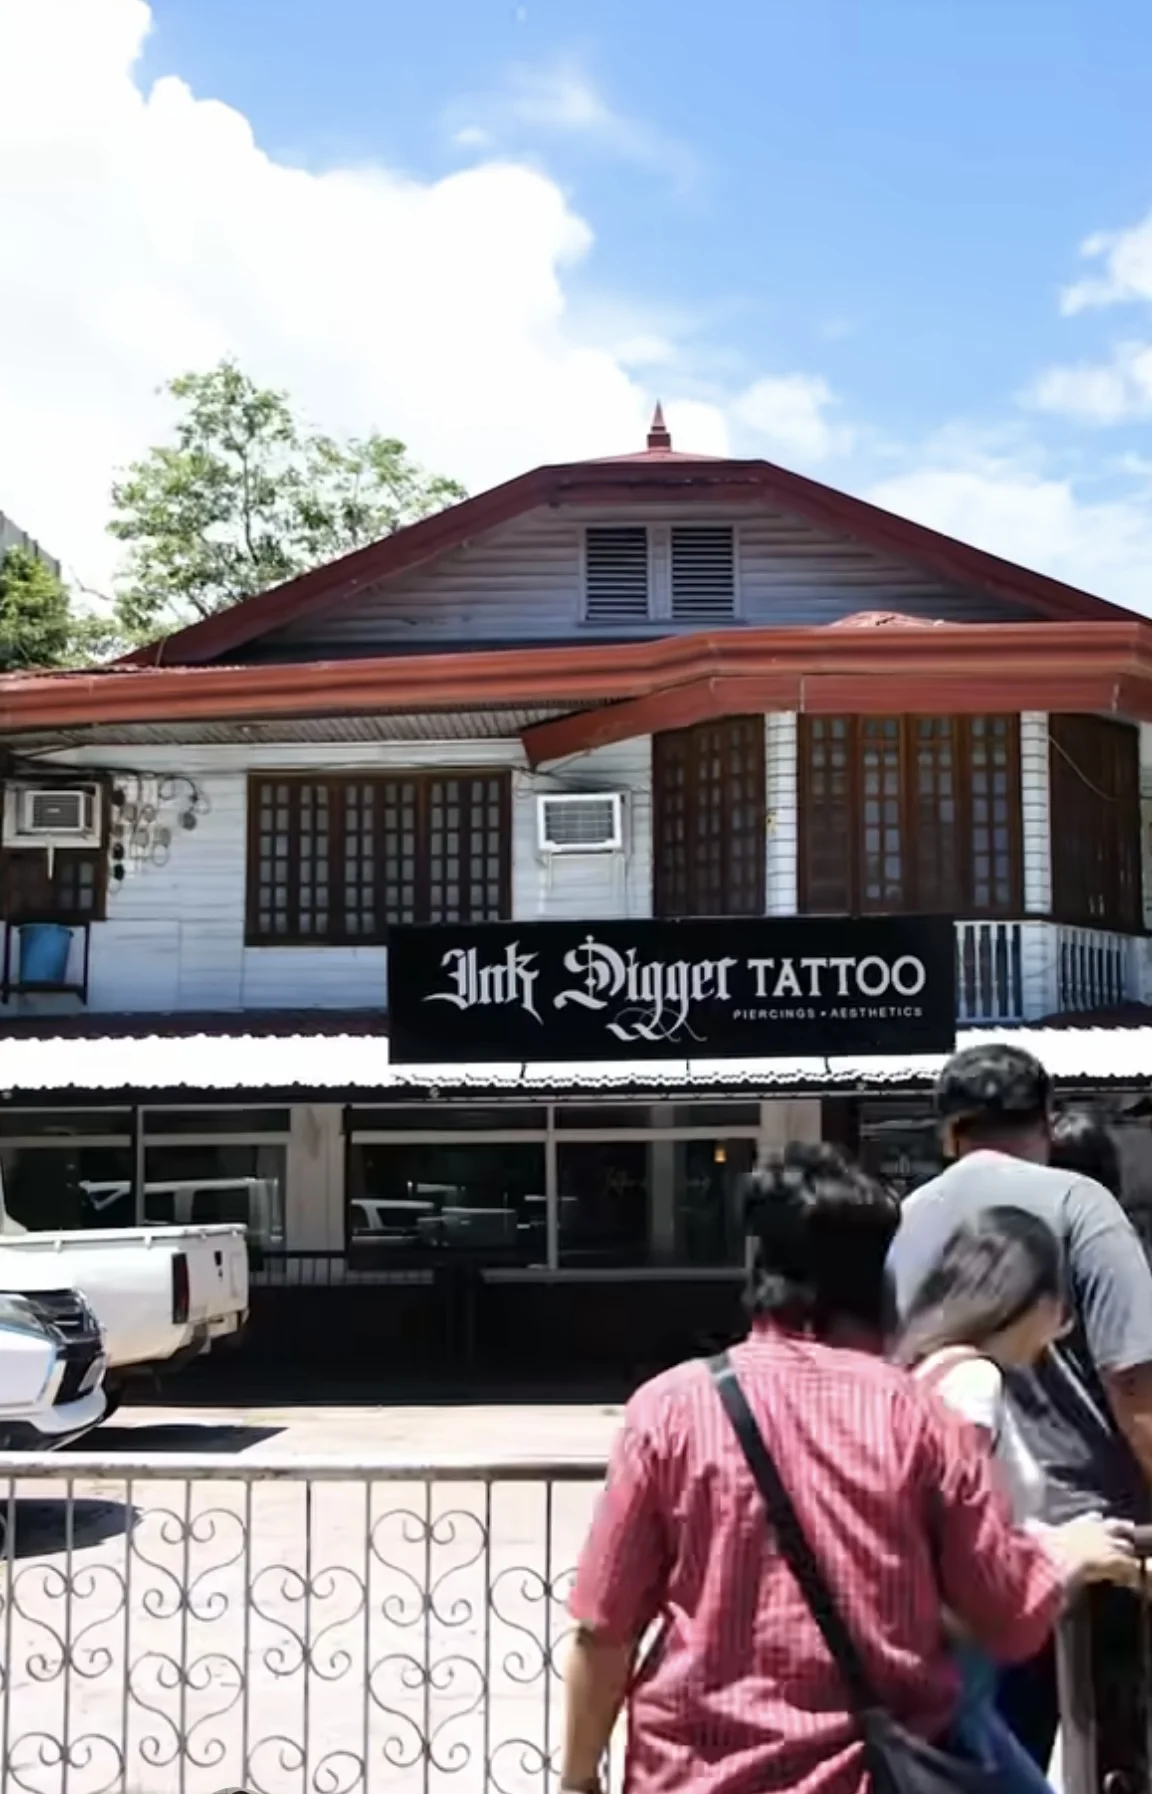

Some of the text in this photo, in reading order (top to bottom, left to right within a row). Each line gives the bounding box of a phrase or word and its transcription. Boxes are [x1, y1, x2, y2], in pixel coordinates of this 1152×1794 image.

[423, 934, 926, 1042] Ink Digger TATTOO
[732, 1006, 923, 1020] PIERCINGS AESTHETICS
